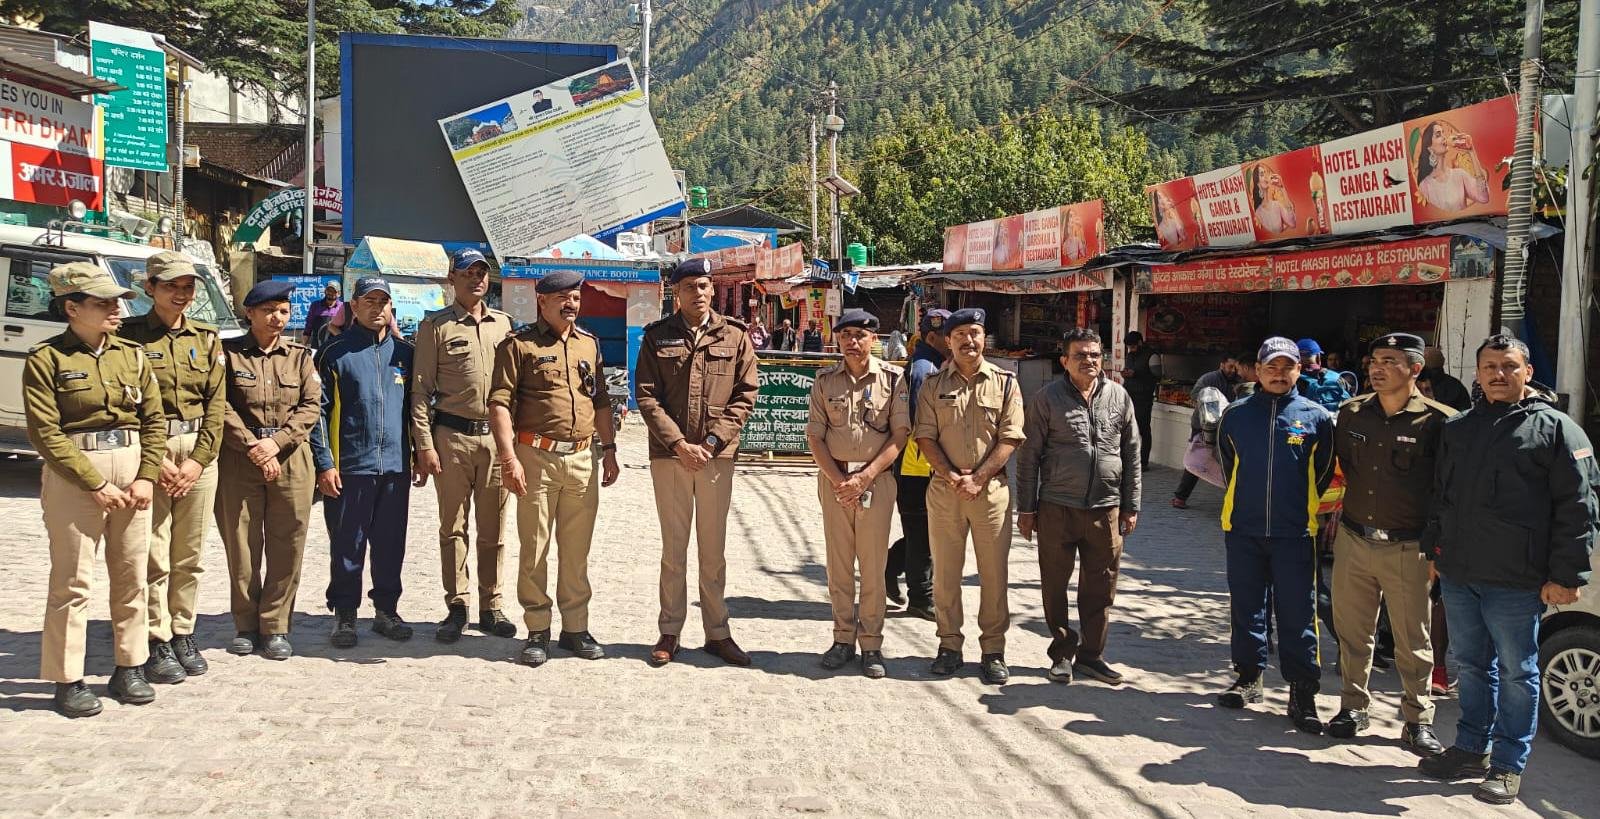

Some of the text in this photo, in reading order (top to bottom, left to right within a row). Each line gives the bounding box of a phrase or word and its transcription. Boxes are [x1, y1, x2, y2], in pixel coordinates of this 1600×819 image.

[1, 83, 63, 115] ES YOU IN
[0, 107, 33, 135] TRI
[1324, 138, 1404, 174] HOTEL AKASH
[1198, 175, 1244, 200] HOTEL AKASH
[1340, 168, 1394, 197] GANGA &
[257, 207, 281, 229] RANGE
[281, 199, 305, 212] OFFICE
[1209, 198, 1241, 218] GANGA &
[1333, 193, 1407, 222] RESTAURANT
[1208, 218, 1251, 238] RESTAURANT
[1025, 247, 1059, 261] RESTAURANT
[1276, 259, 1300, 273] HOTEL
[1302, 256, 1329, 271] AKASH
[1332, 254, 1362, 269] GANGA
[1365, 253, 1374, 265] &
[1377, 244, 1448, 264] RESTAURANT
[611, 271, 639, 279] BOOTH
